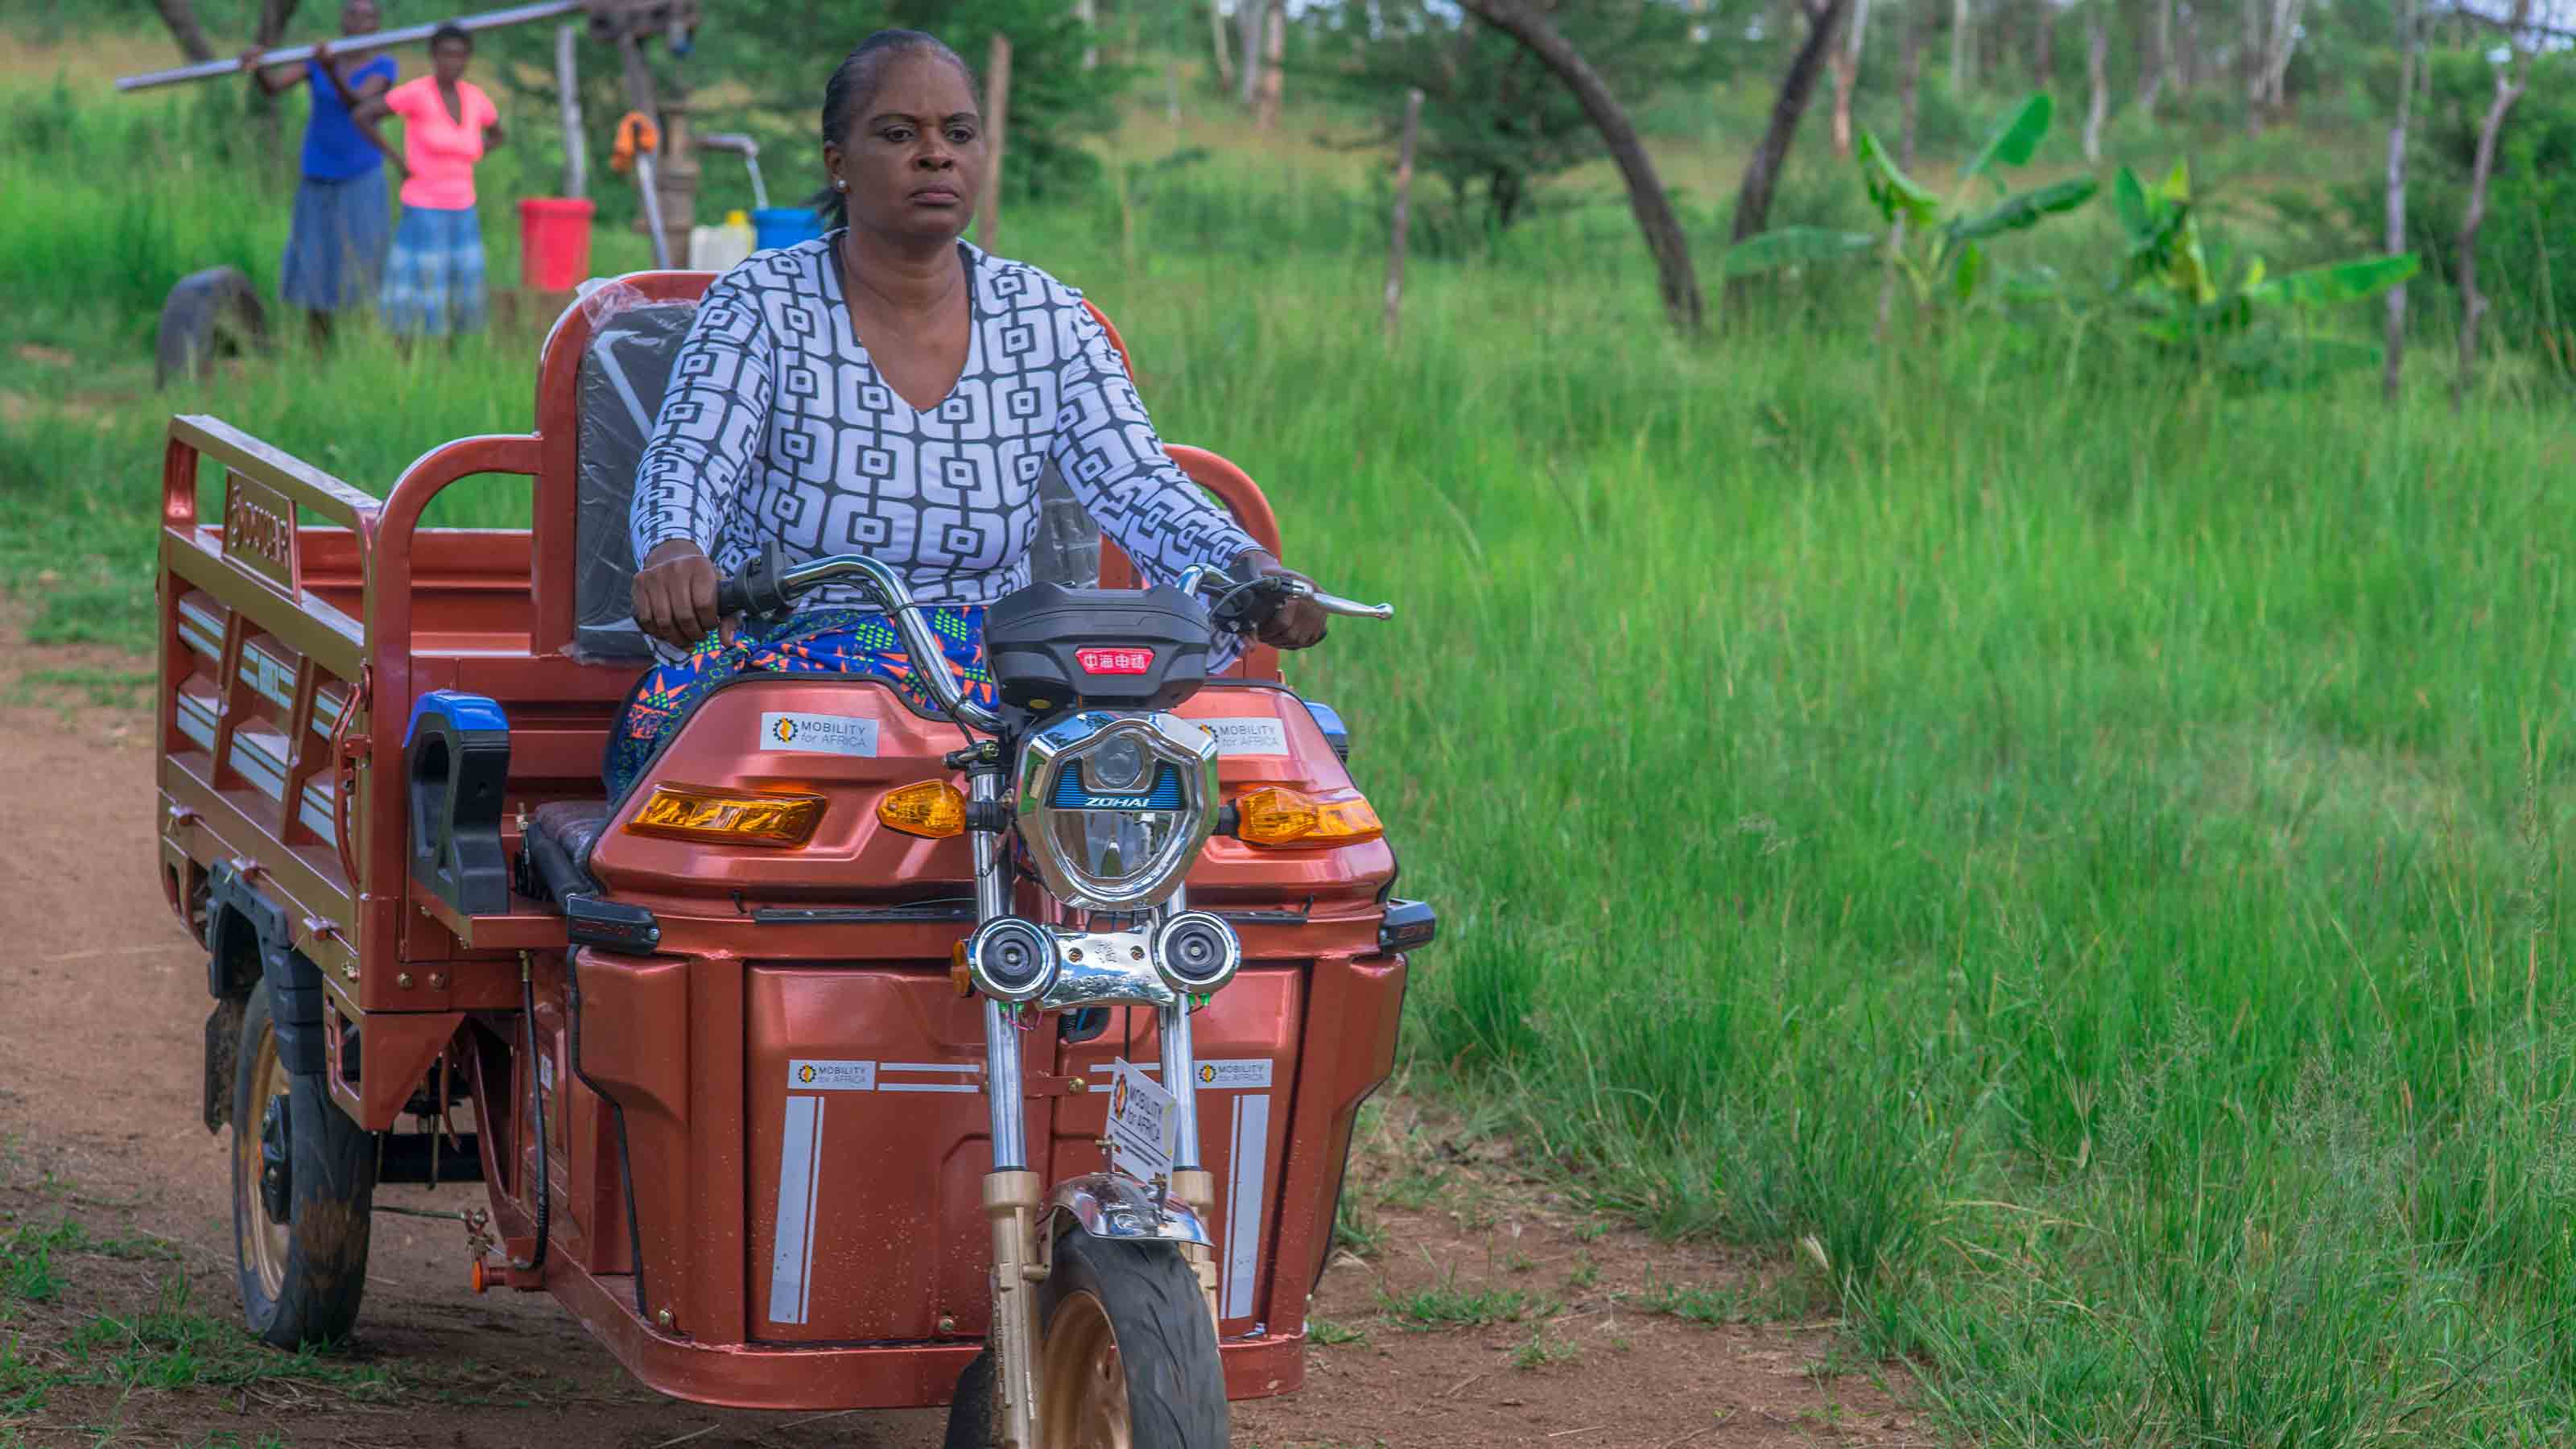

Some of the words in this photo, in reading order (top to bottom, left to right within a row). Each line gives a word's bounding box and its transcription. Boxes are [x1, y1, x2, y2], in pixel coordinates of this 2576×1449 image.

[800, 720, 866, 735] MOBILITY
[1219, 724, 1275, 736] MOBILITY
[800, 733, 818, 743] for
[822, 734, 867, 748] AFRICA
[1222, 737, 1237, 747] for
[1240, 736, 1279, 747] AFRICA
[1084, 797, 1150, 807] ZOHAI
[818, 1066, 866, 1075] MOBILITY
[1218, 1065, 1264, 1074] MOBILITY
[1129, 1084, 1162, 1121] MOBILITY
[1137, 1113, 1160, 1141] AFRICA
